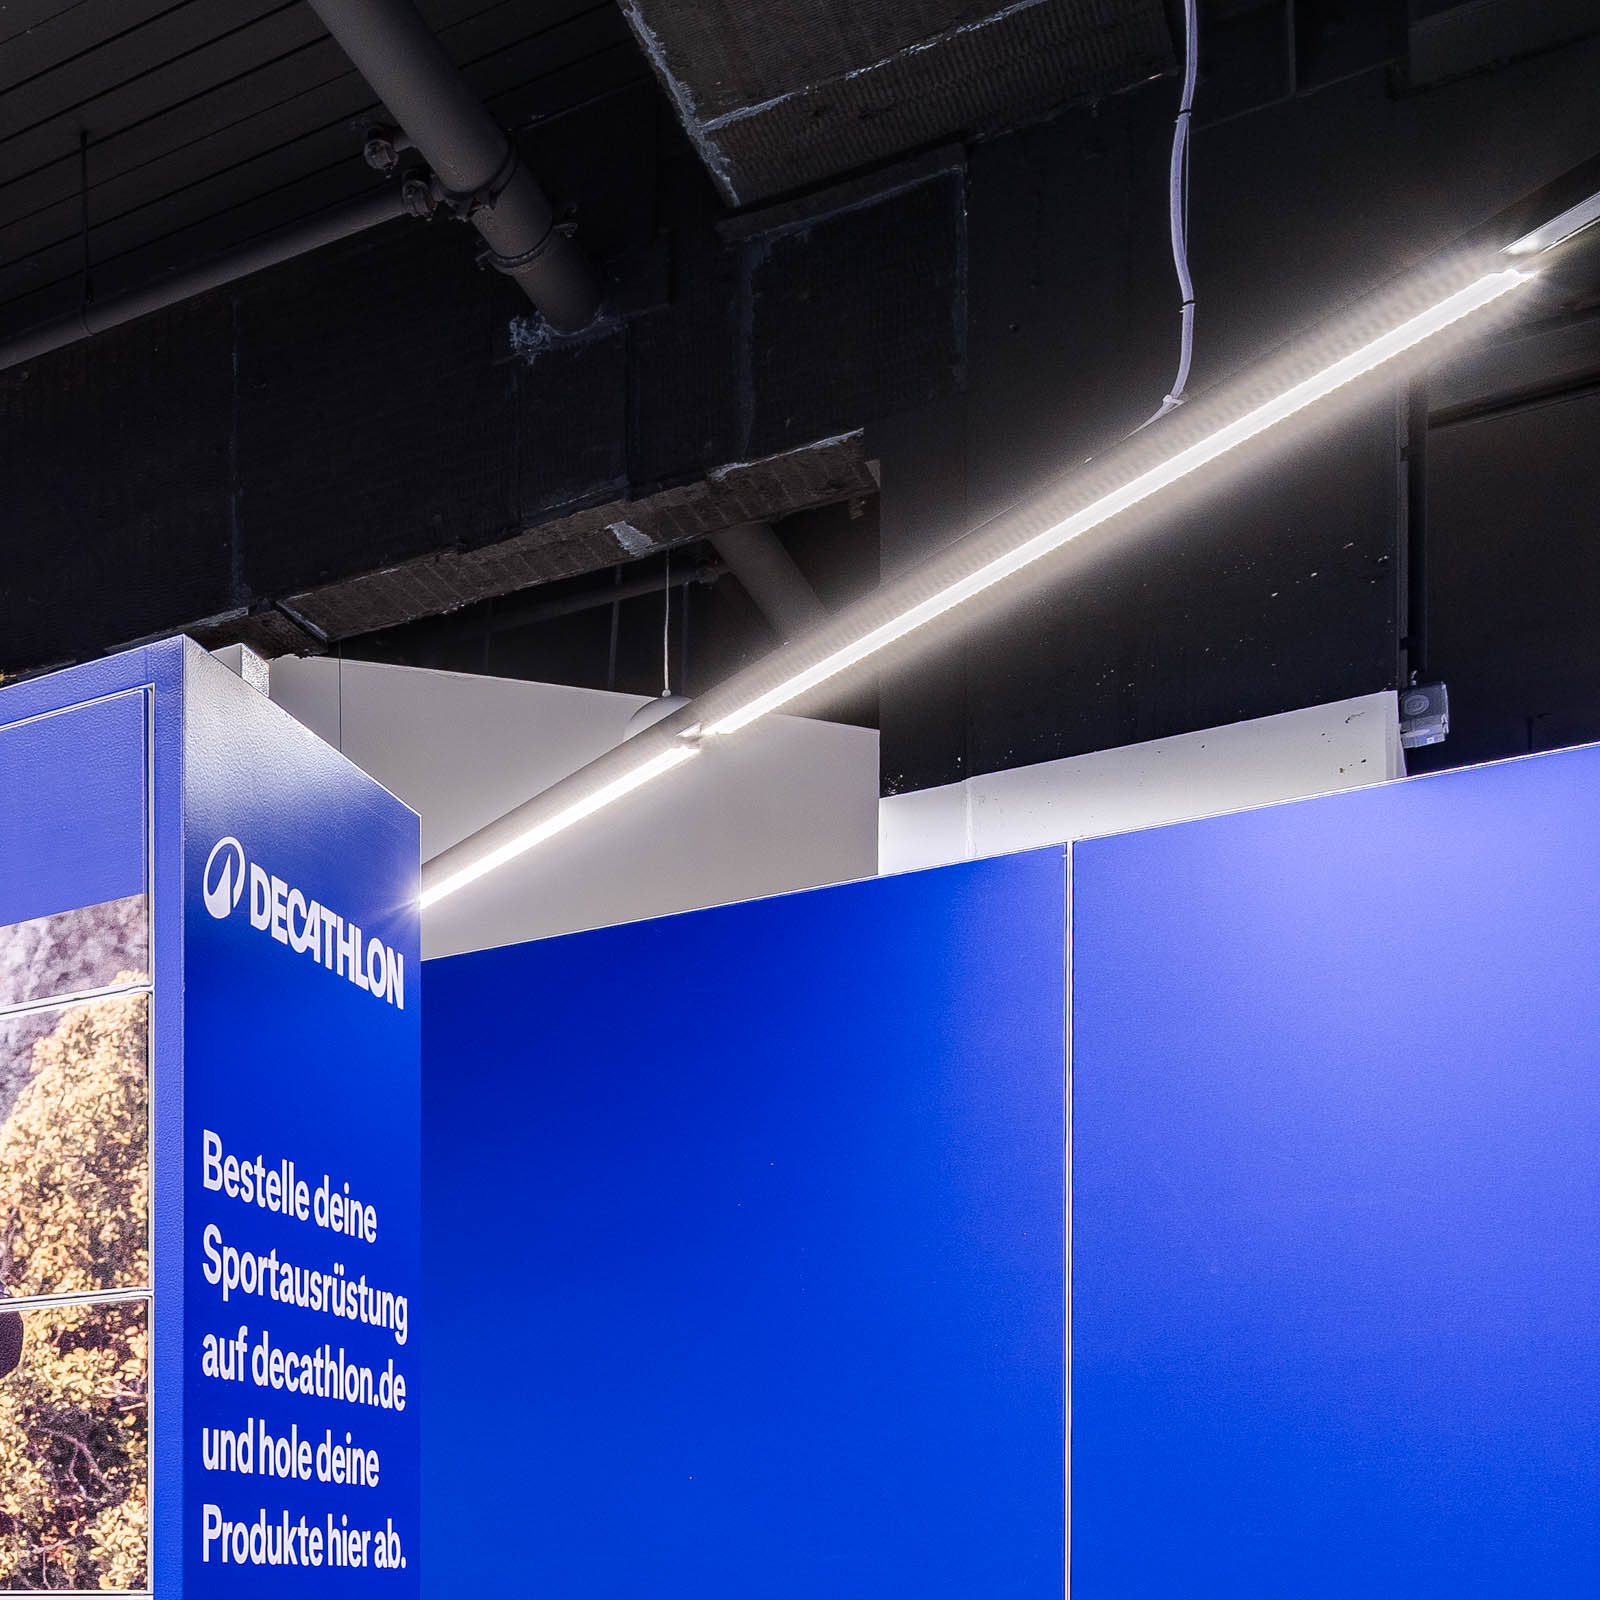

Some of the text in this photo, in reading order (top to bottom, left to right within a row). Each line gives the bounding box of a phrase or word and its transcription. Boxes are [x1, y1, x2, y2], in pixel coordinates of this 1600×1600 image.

[250, 862, 404, 1010] DECATHLON
[203, 1129, 377, 1244] Bestelle deine
[202, 1223, 408, 1345] Sportausrüstung
[202, 1325, 406, 1411] auf decathlon.de
[202, 1417, 380, 1488] und hole deine
[203, 1503, 407, 1569] Produkte hier ab.
